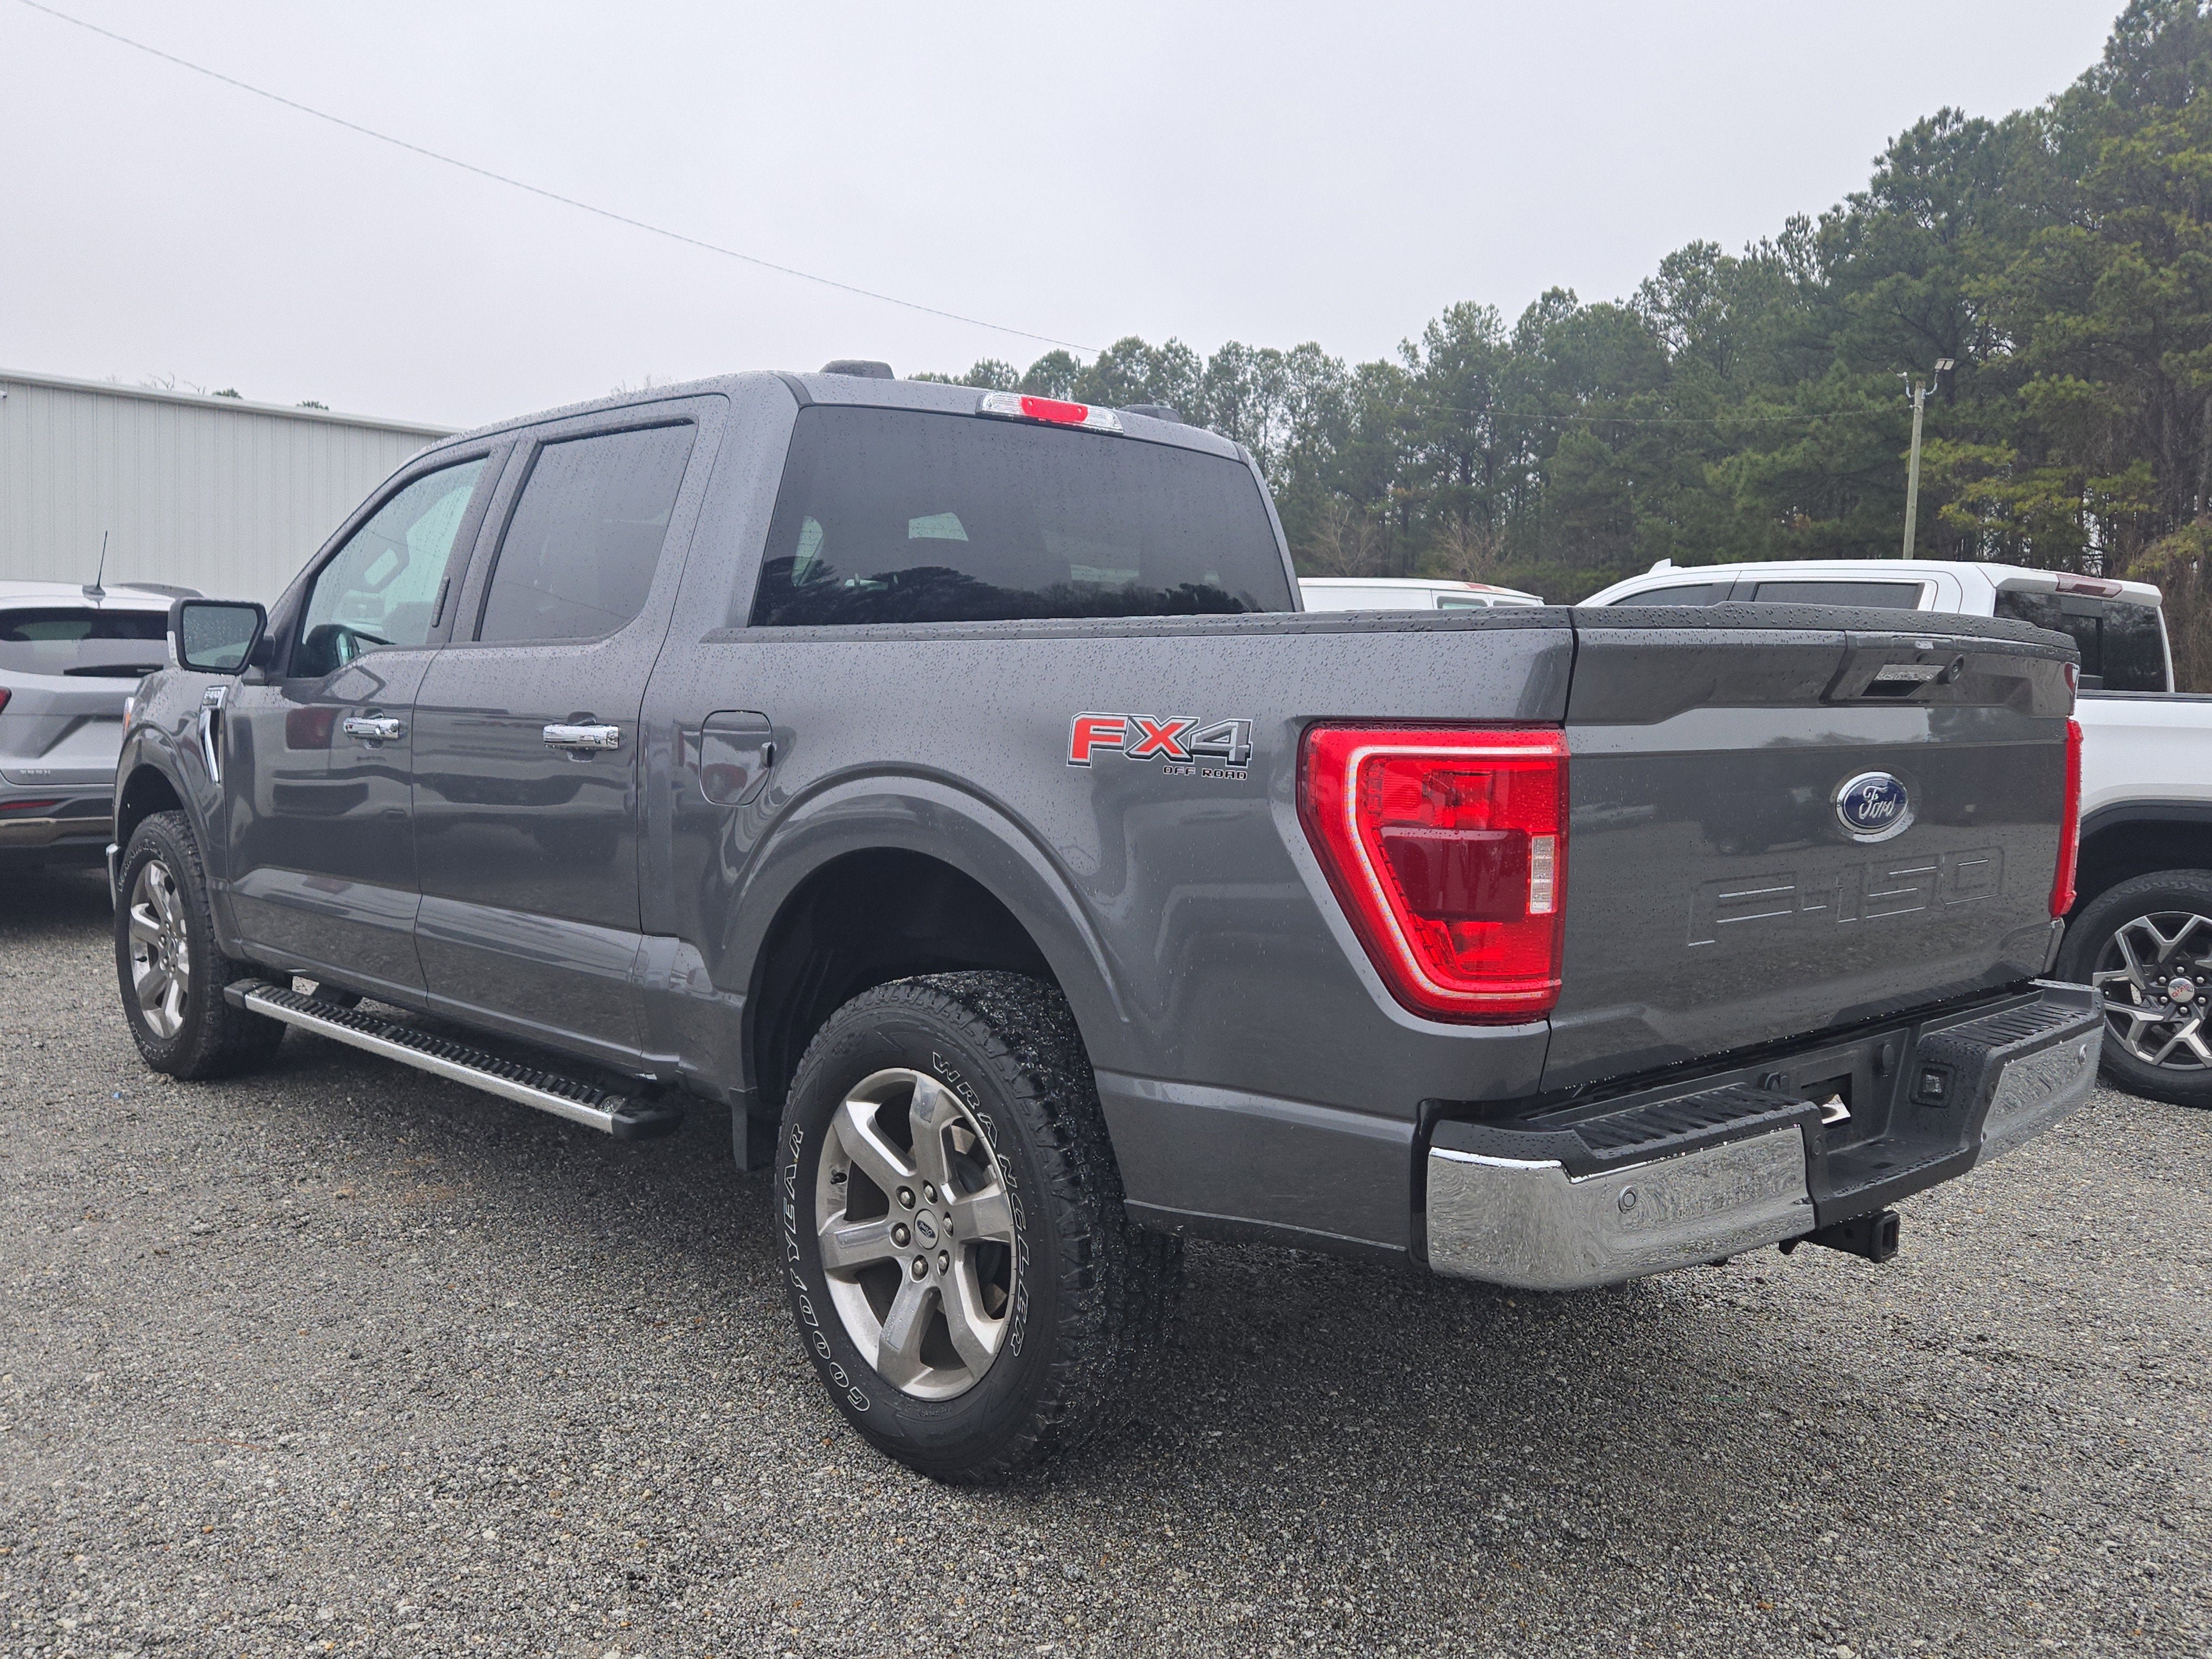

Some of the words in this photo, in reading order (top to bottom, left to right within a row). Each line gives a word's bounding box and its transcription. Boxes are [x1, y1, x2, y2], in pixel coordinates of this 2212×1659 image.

[1066, 711, 1253, 768] FX4
[1162, 765, 1195, 776] OFF
[1201, 767, 1248, 780] ROAD
[1858, 785, 1897, 820] Ford
[2172, 983, 2190, 998] GMC
[933, 1051, 1030, 1357] WRANGLER
[918, 1222, 933, 1237] Ford
[783, 1123, 870, 1412] GOODYEAR
